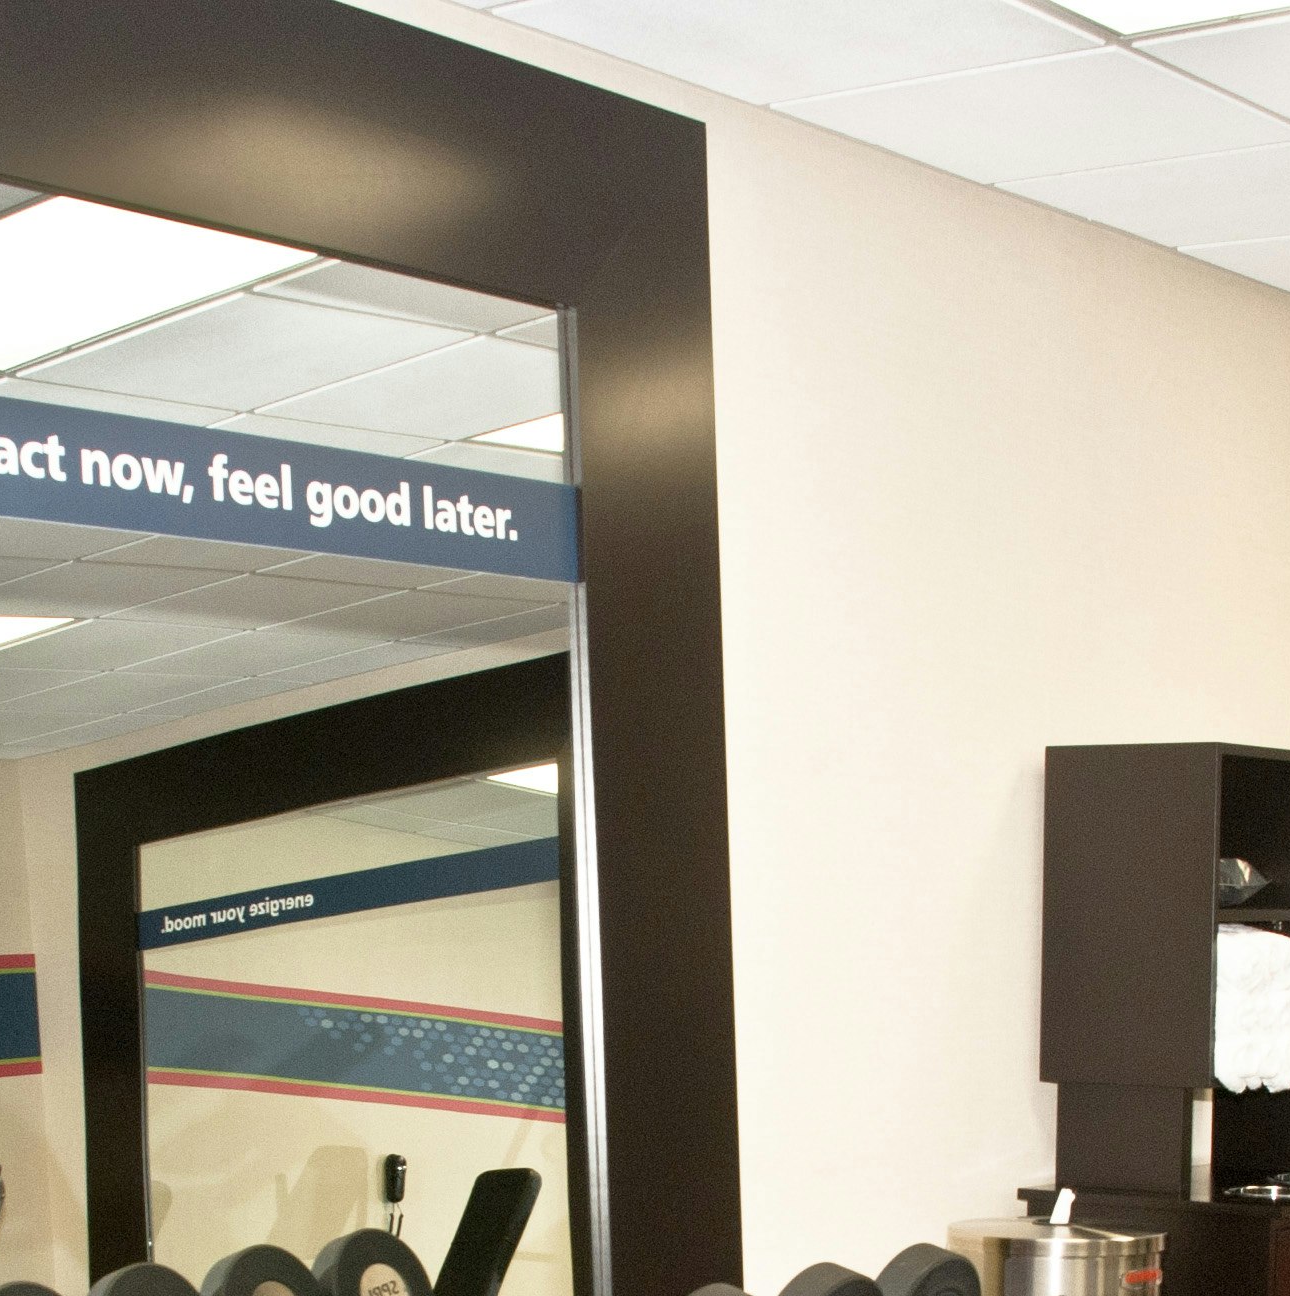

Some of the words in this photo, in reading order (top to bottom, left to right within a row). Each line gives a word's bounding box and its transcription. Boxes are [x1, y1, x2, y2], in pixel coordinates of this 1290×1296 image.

[80, 447, 195, 504] now,
[208, 453, 292, 511] feel
[306, 481, 410, 529] good
[422, 486, 518, 541] later.
